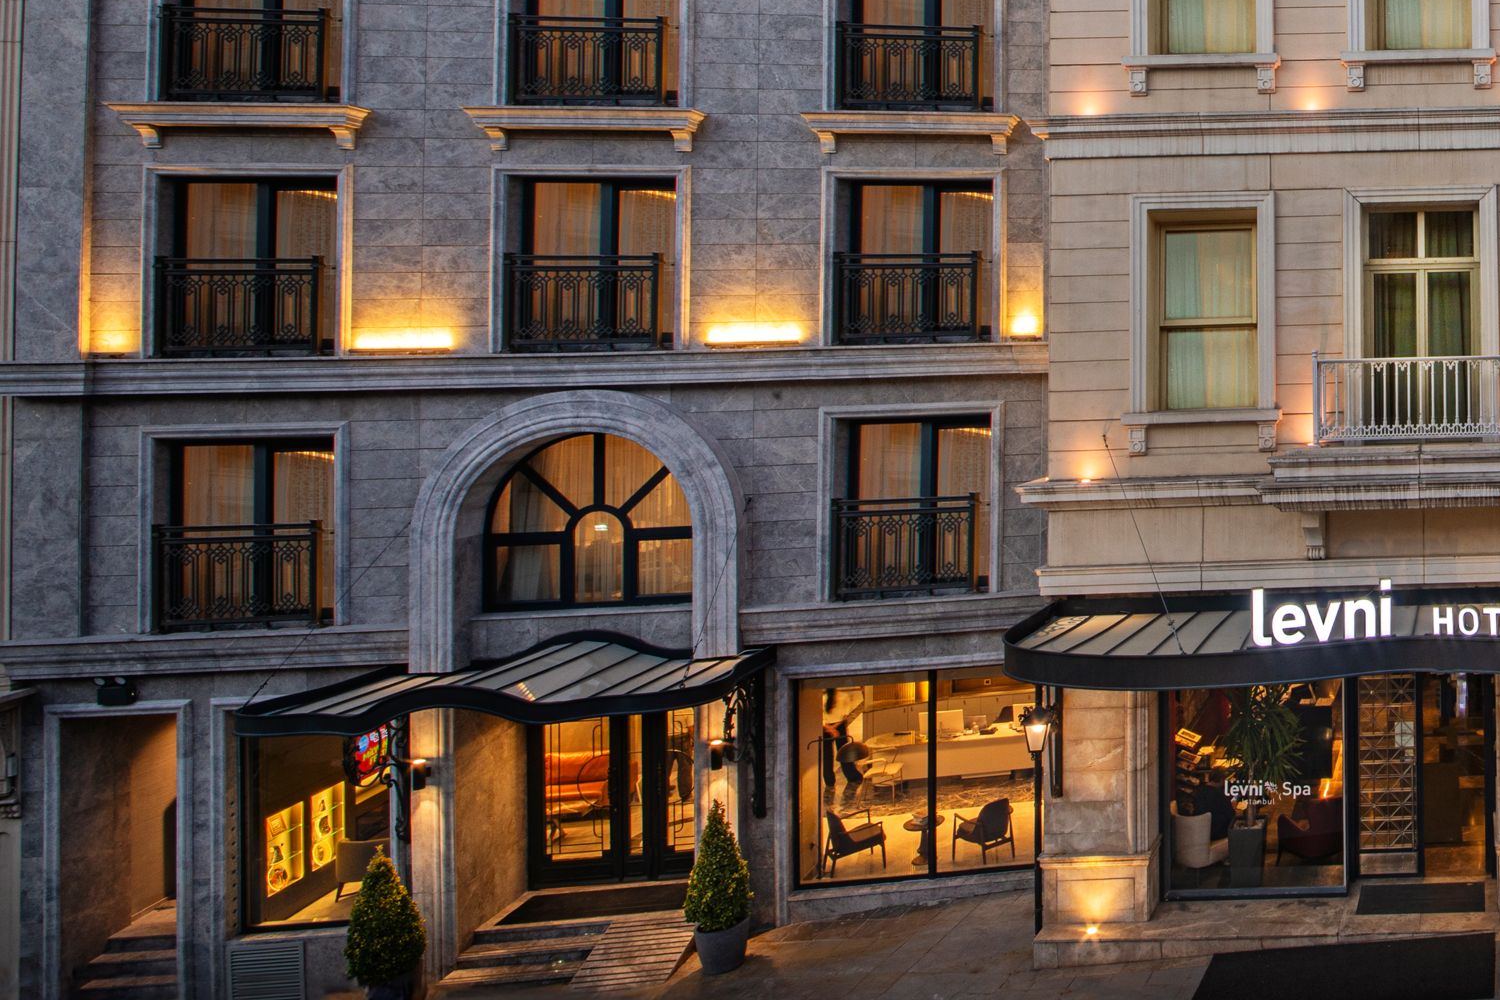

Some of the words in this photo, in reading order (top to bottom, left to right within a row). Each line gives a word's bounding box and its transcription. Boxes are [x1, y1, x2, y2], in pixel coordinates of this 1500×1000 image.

[1251, 578, 1392, 647] levni
[1224, 780, 1263, 797] levni
[1282, 782, 1311, 799] Spa
